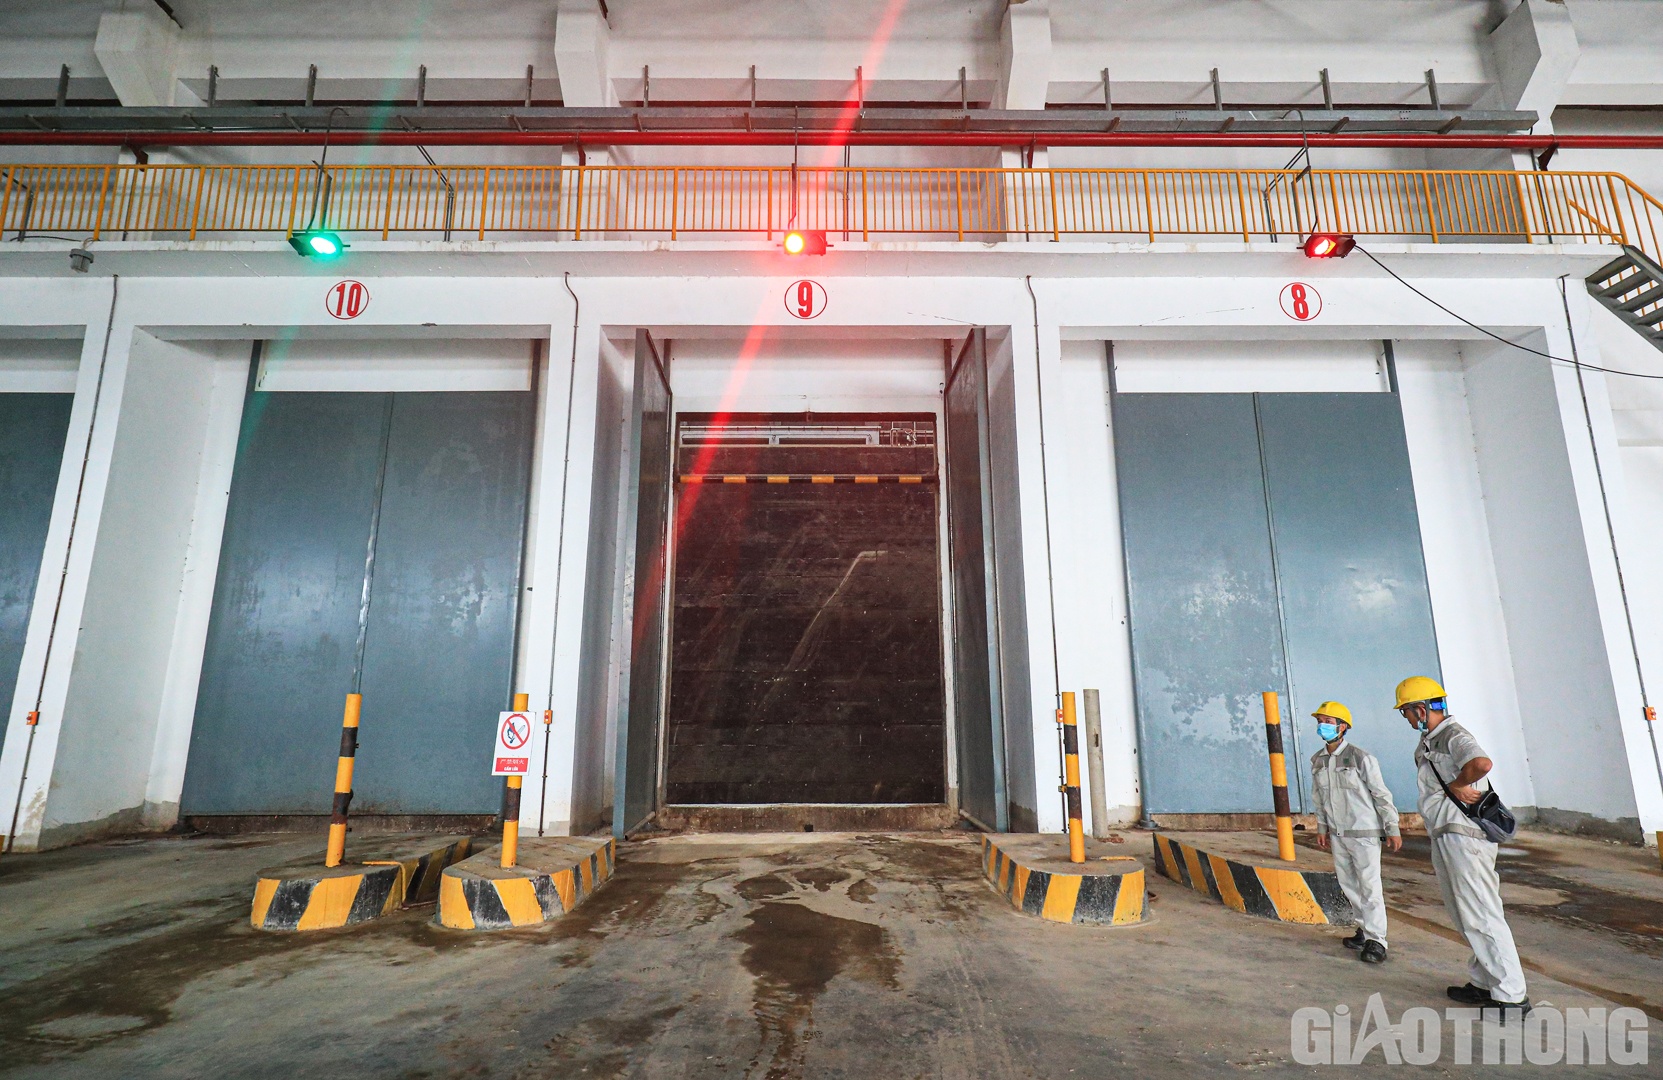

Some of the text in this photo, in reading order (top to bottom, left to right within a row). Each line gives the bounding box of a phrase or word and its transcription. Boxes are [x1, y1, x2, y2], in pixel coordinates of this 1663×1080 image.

[336, 283, 362, 317] 10
[797, 281, 813, 318] 9
[1291, 284, 1309, 320] 8
